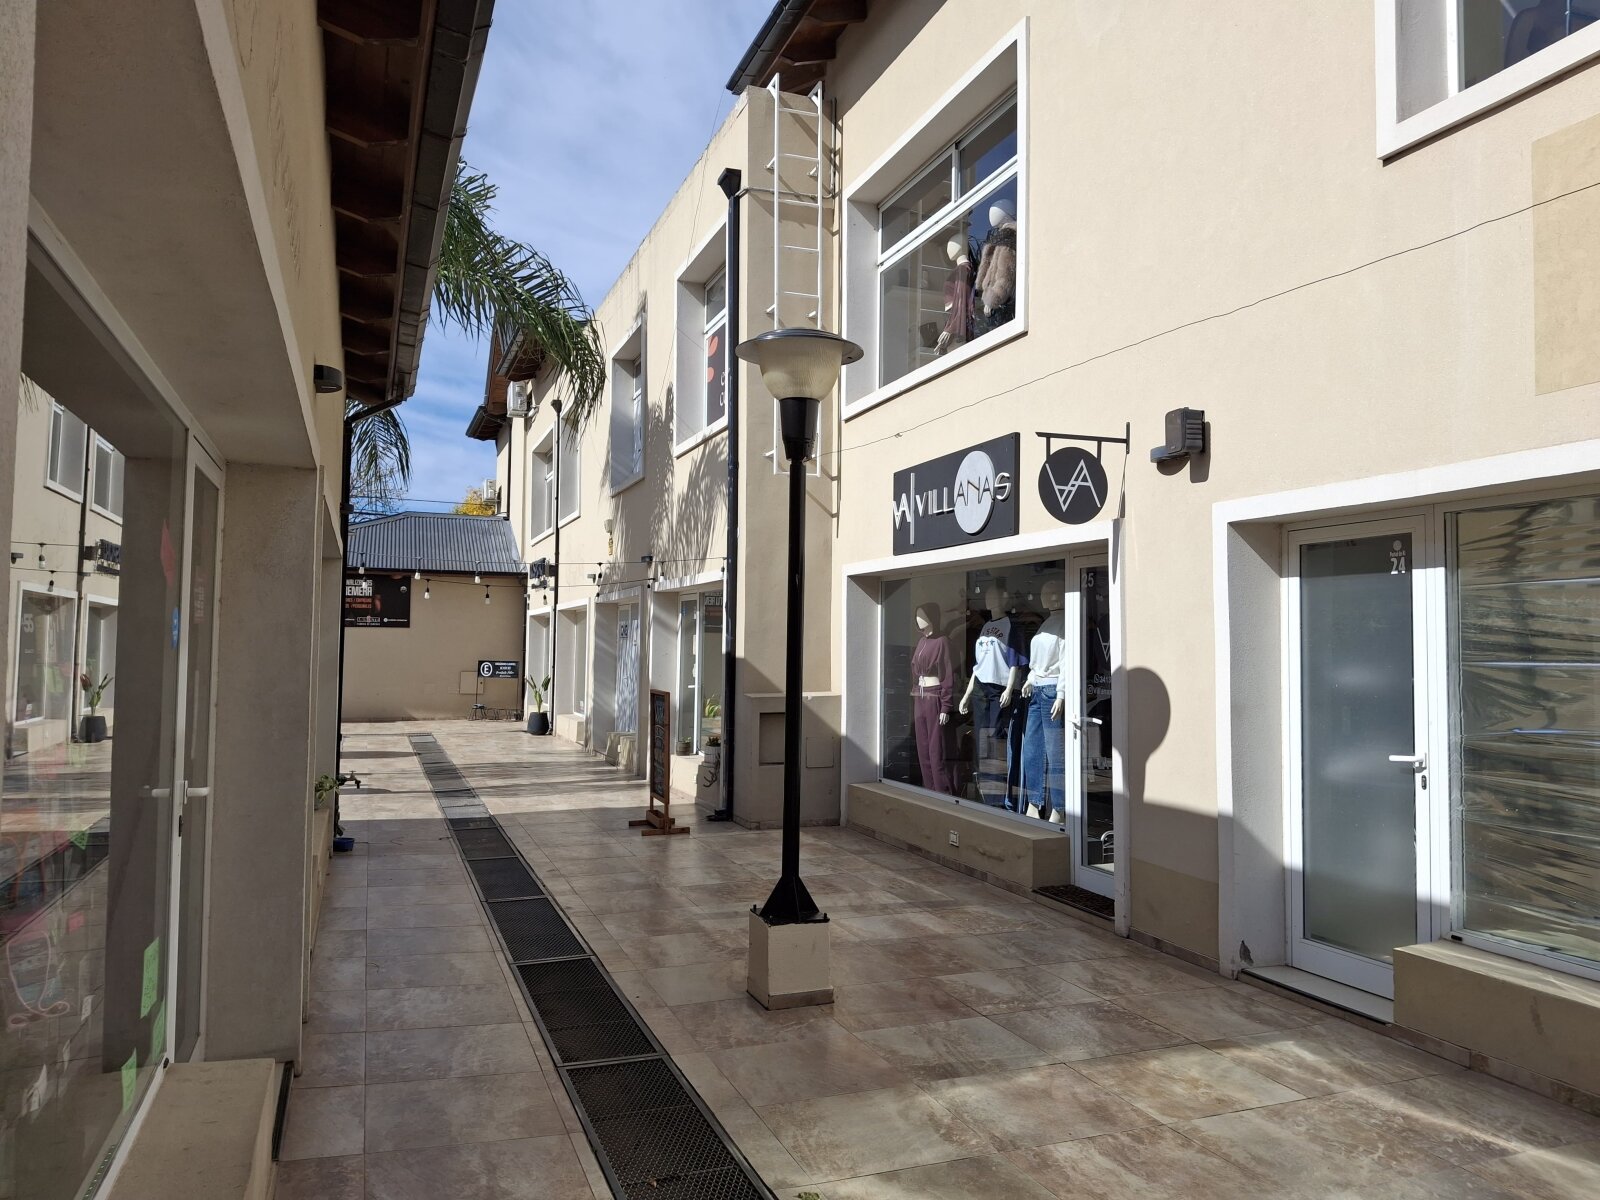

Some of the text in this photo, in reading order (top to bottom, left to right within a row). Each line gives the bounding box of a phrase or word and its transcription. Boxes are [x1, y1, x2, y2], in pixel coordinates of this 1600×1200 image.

[916, 472, 1012, 517] VILLANAS
[1390, 557, 1406, 574] 24
[1082, 573, 1094, 588] 25
